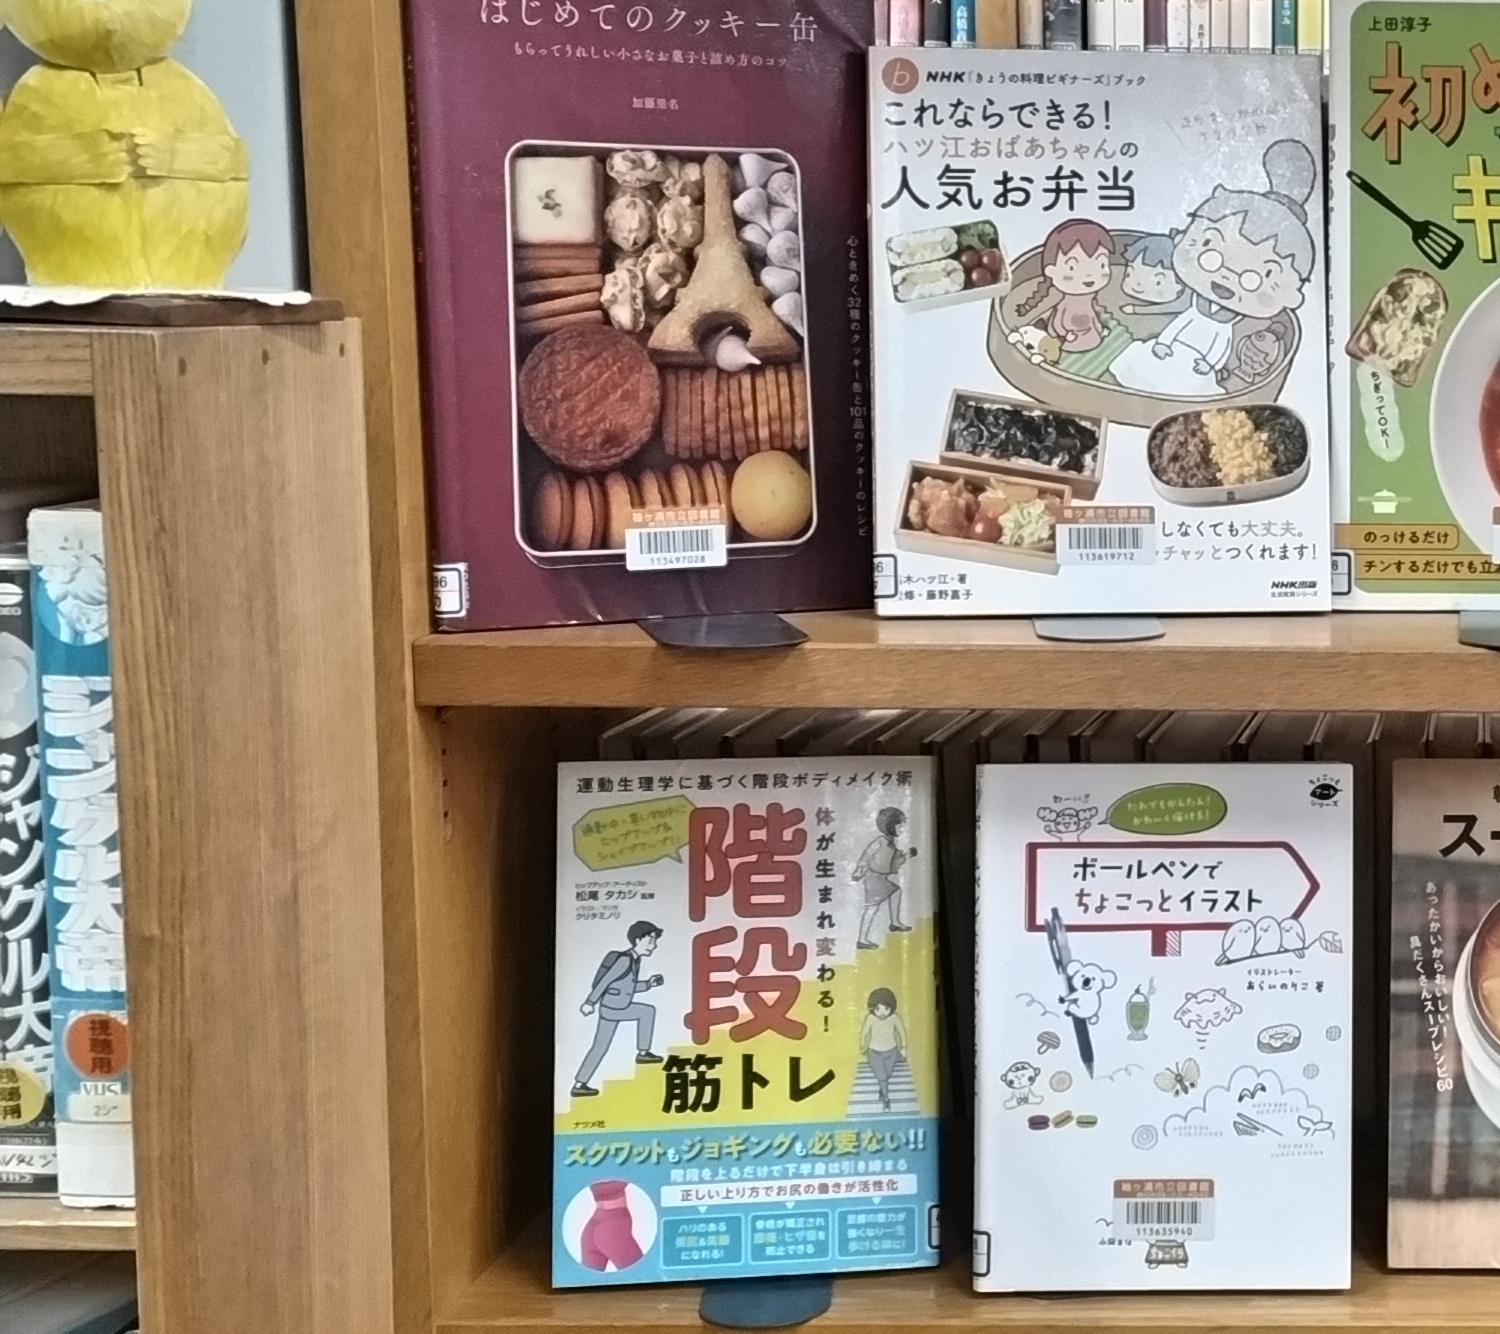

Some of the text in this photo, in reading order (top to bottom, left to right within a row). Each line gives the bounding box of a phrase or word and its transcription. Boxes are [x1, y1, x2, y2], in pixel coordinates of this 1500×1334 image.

[1367, 15, 1433, 34] 上田淳子
[884, 99, 1112, 131] これならできる!
[883, 135, 1140, 161] ハツ江おばあちゃんの
[880, 165, 1137, 213] 人気お弁当
[1160, 519, 1306, 539] しなくても大丈夫。
[1363, 529, 1451, 546] のっけるだけ
[650, 554, 706, 566] 113497028
[1078, 550, 1135, 563] 113619712
[576, 770, 913, 794] 運動生理学に基づく階段ボディメイク術
[1072, 856, 1224, 882] ボールペンで
[1074, 887, 1264, 915] ちょこっとイラスト
[684, 801, 809, 1046] 階段
[814, 805, 837, 1034] 体が生まれ変わる!
[661, 1053, 837, 1115] 筋トレ
[563, 1127, 927, 1167] スクワットもジョギングも必要ない!!
[669, 1158, 909, 1183] 階段を上るだけで下半身は引き締まる
[680, 1180, 900, 1204] 正しい上り方でお尻の働きが活性化
[1136, 1226, 1193, 1238] 113635940
